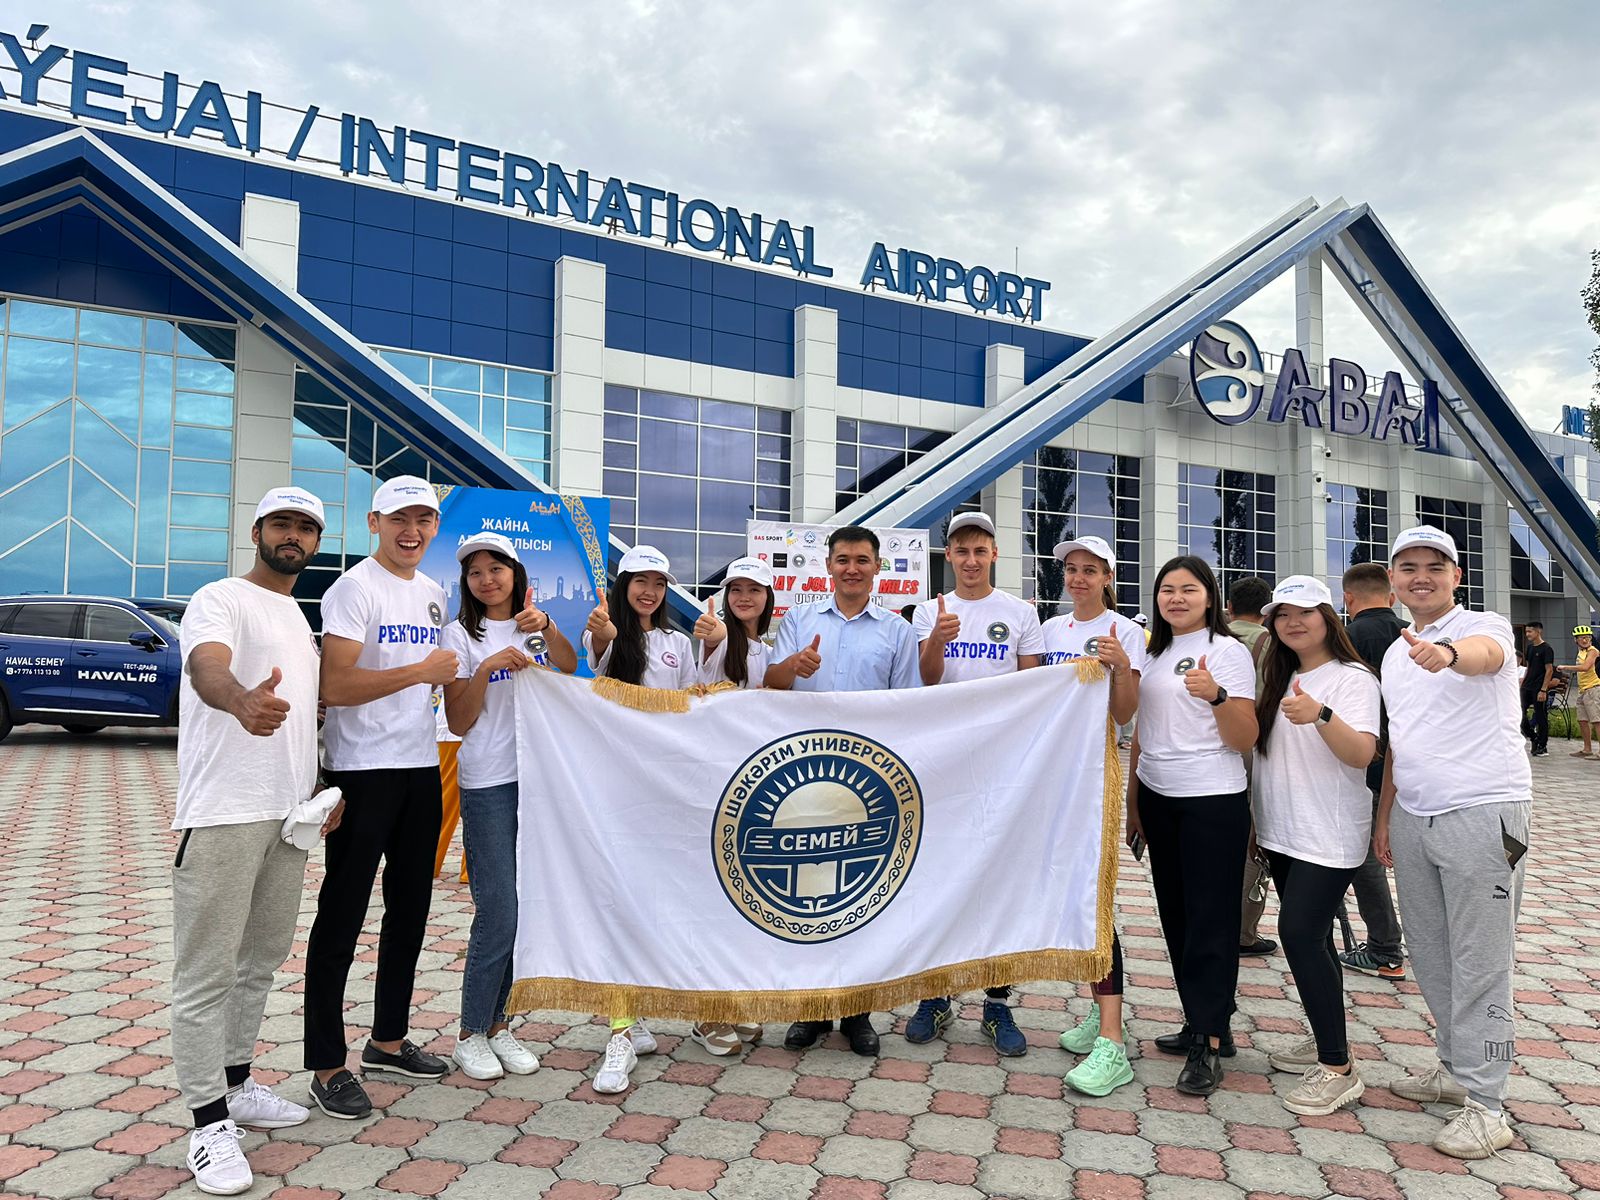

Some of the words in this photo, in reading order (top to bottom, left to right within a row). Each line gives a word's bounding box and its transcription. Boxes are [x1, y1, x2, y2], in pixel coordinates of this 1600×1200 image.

[0, 24, 261, 154] ÝEJAI
[340, 112, 833, 278] INTERNATIONAL
[860, 242, 1050, 321] AIRPORT
[1267, 348, 1440, 449] ABAI
[878, 579, 919, 595] MILES
[5, 656, 33, 666] HAVAL
[34, 657, 65, 667] SEMEY
[944, 641, 1009, 661] ЕКТОРАТ
[78, 670, 137, 682] HAVAL
[138, 673, 158, 683] H6
[724, 743, 795, 819] ШӘКӘРІМ
[798, 737, 915, 806] УНИВЕРСИТЕТІ
[779, 825, 860, 851] СЕМЕЙ
